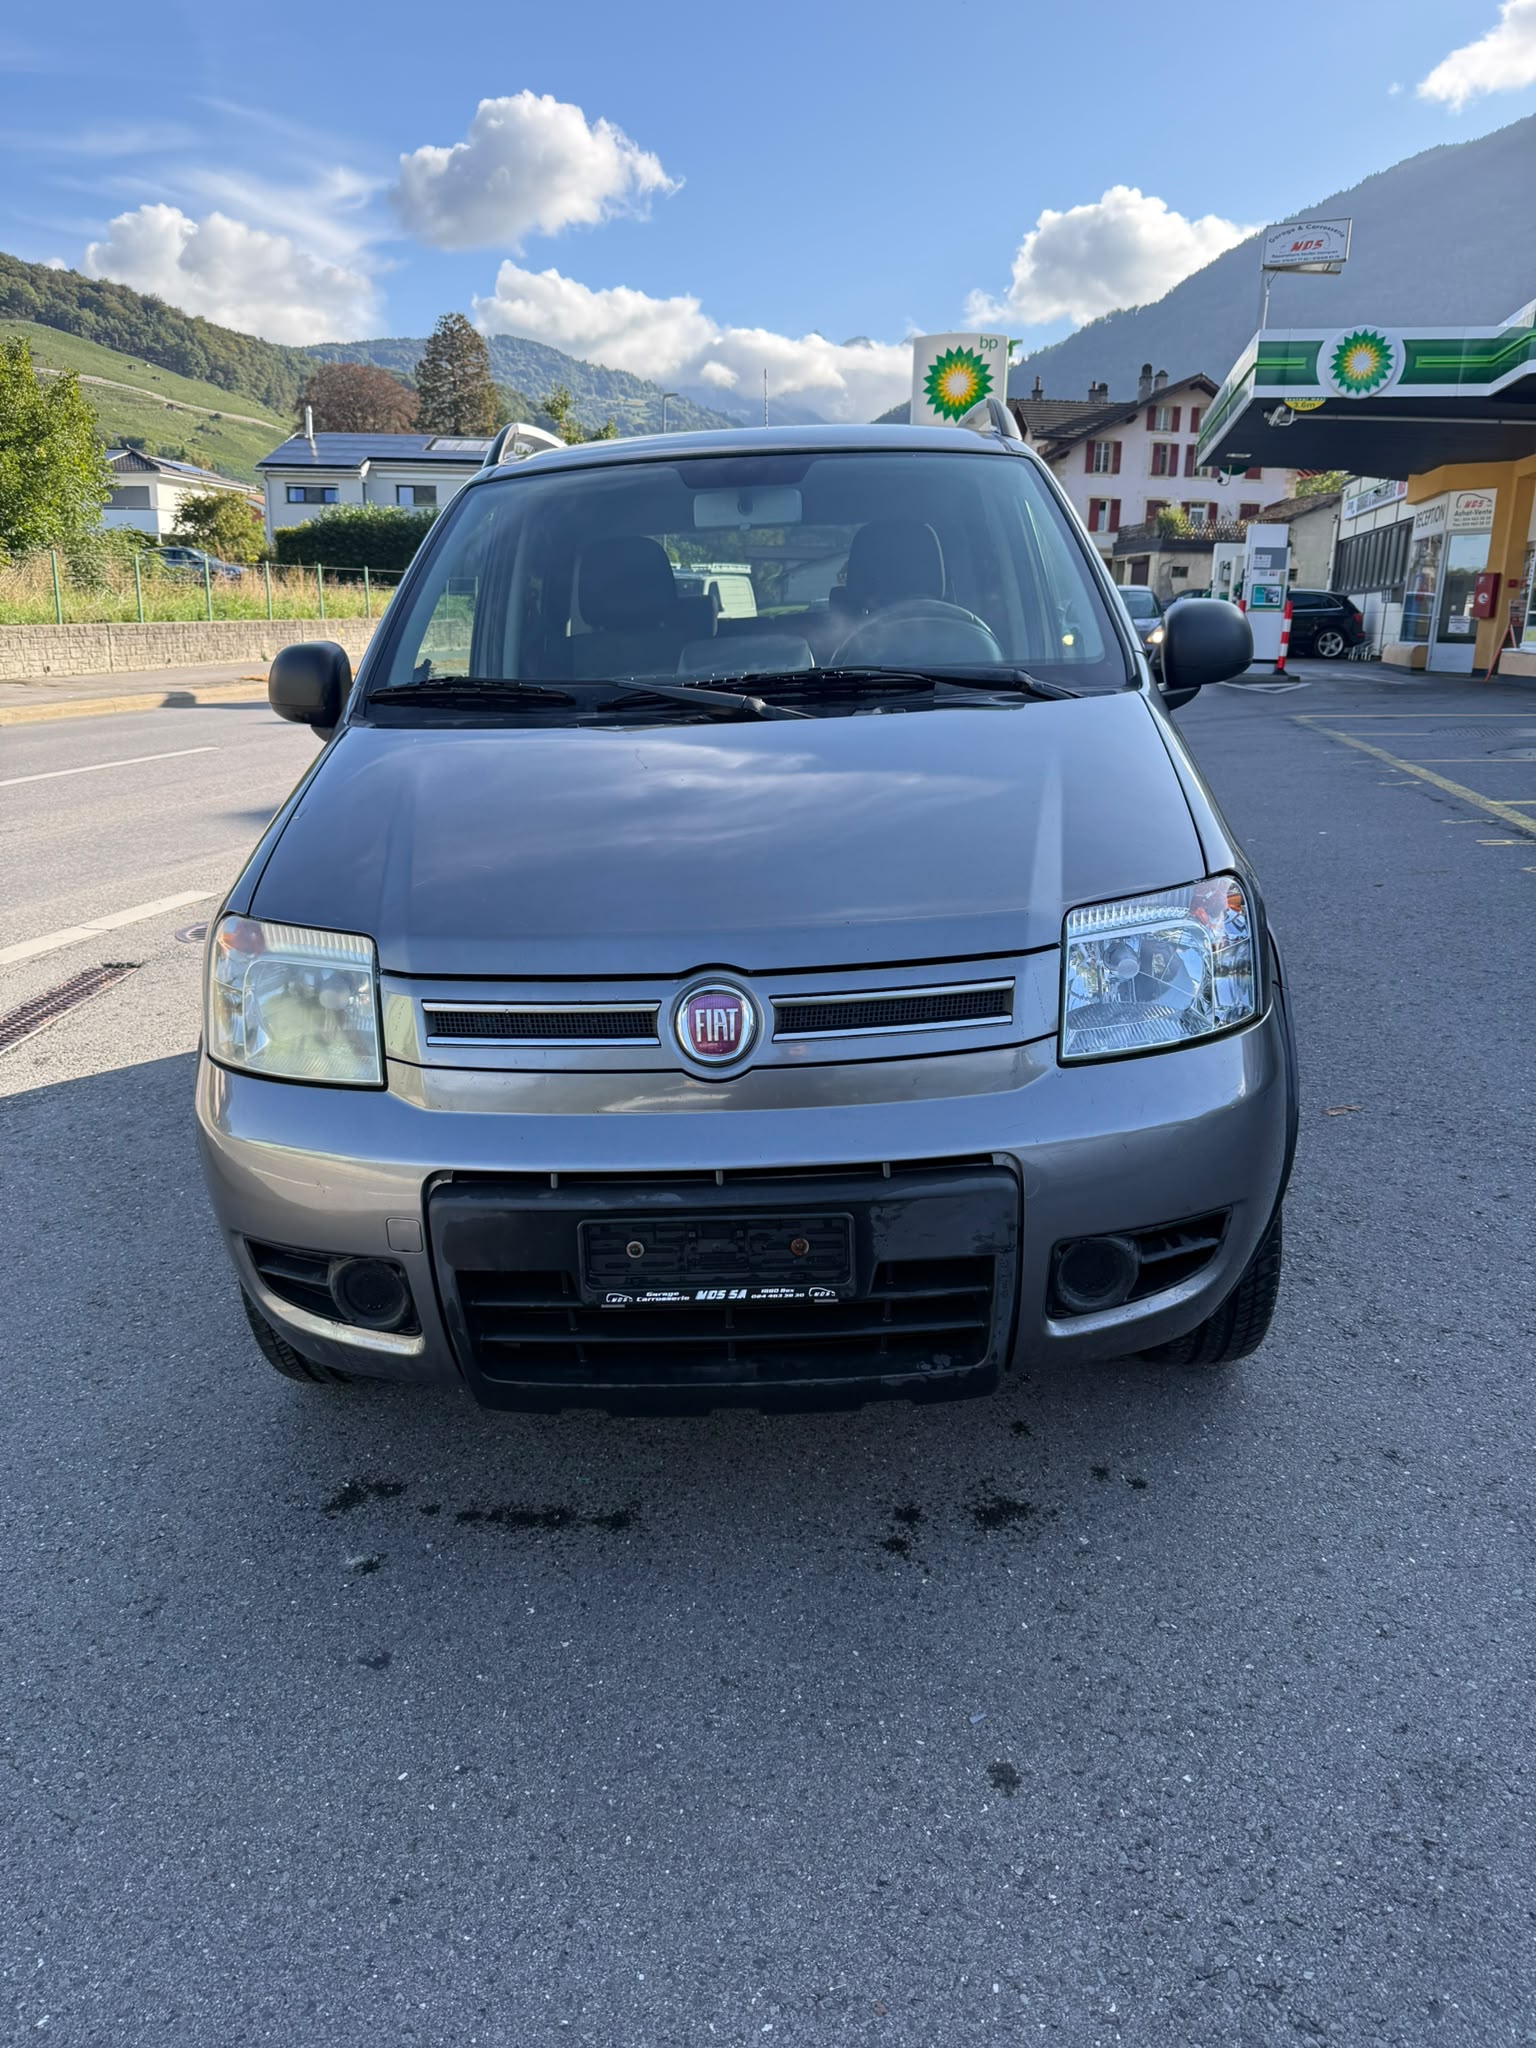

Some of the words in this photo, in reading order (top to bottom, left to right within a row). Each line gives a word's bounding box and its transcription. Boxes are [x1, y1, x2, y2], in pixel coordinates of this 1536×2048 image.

[1269, 228, 1295, 243] Garage
[1306, 224, 1345, 238] Carrosserie
[979, 336, 998, 352] bp
[695, 1008, 739, 1043] FIAT
[727, 1288, 748, 1299] SA
